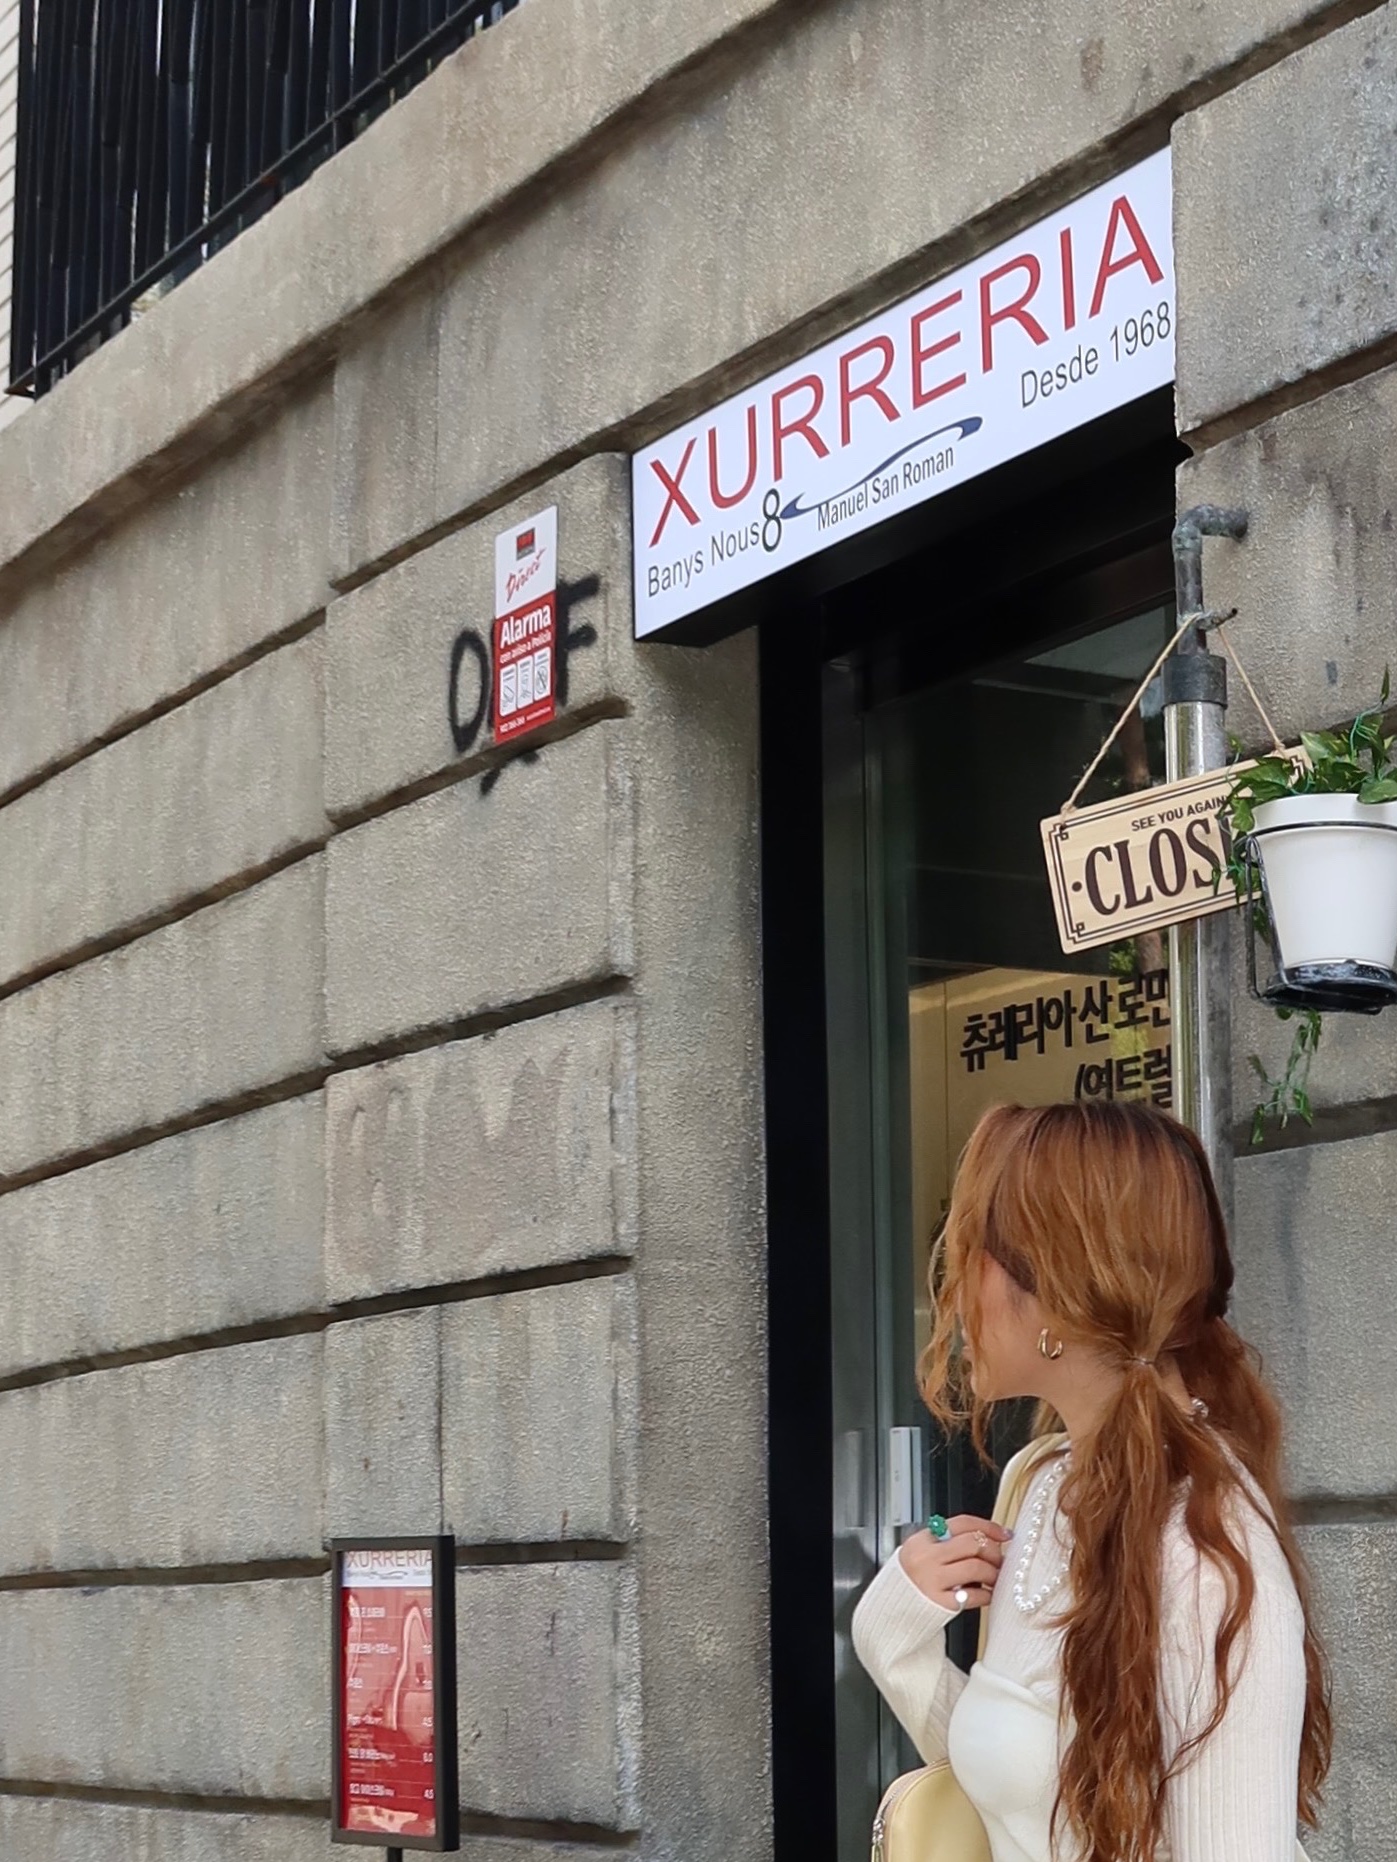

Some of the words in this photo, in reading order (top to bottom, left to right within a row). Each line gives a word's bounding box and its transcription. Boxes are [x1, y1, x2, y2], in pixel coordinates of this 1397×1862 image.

[649, 195, 1164, 548] XURRERIA
[1021, 344, 1099, 408] Desde
[1110, 301, 1171, 362] 1968
[817, 482, 869, 531] Manuel
[872, 474, 900, 504] San
[902, 447, 954, 490] Roman
[649, 549, 704, 598] Banys
[711, 520, 760, 566] Nous
[762, 488, 782, 552] 8
[500, 604, 551, 649] Alarma
[1131, 814, 1156, 832] SEE
[1157, 807, 1184, 824] YOU
